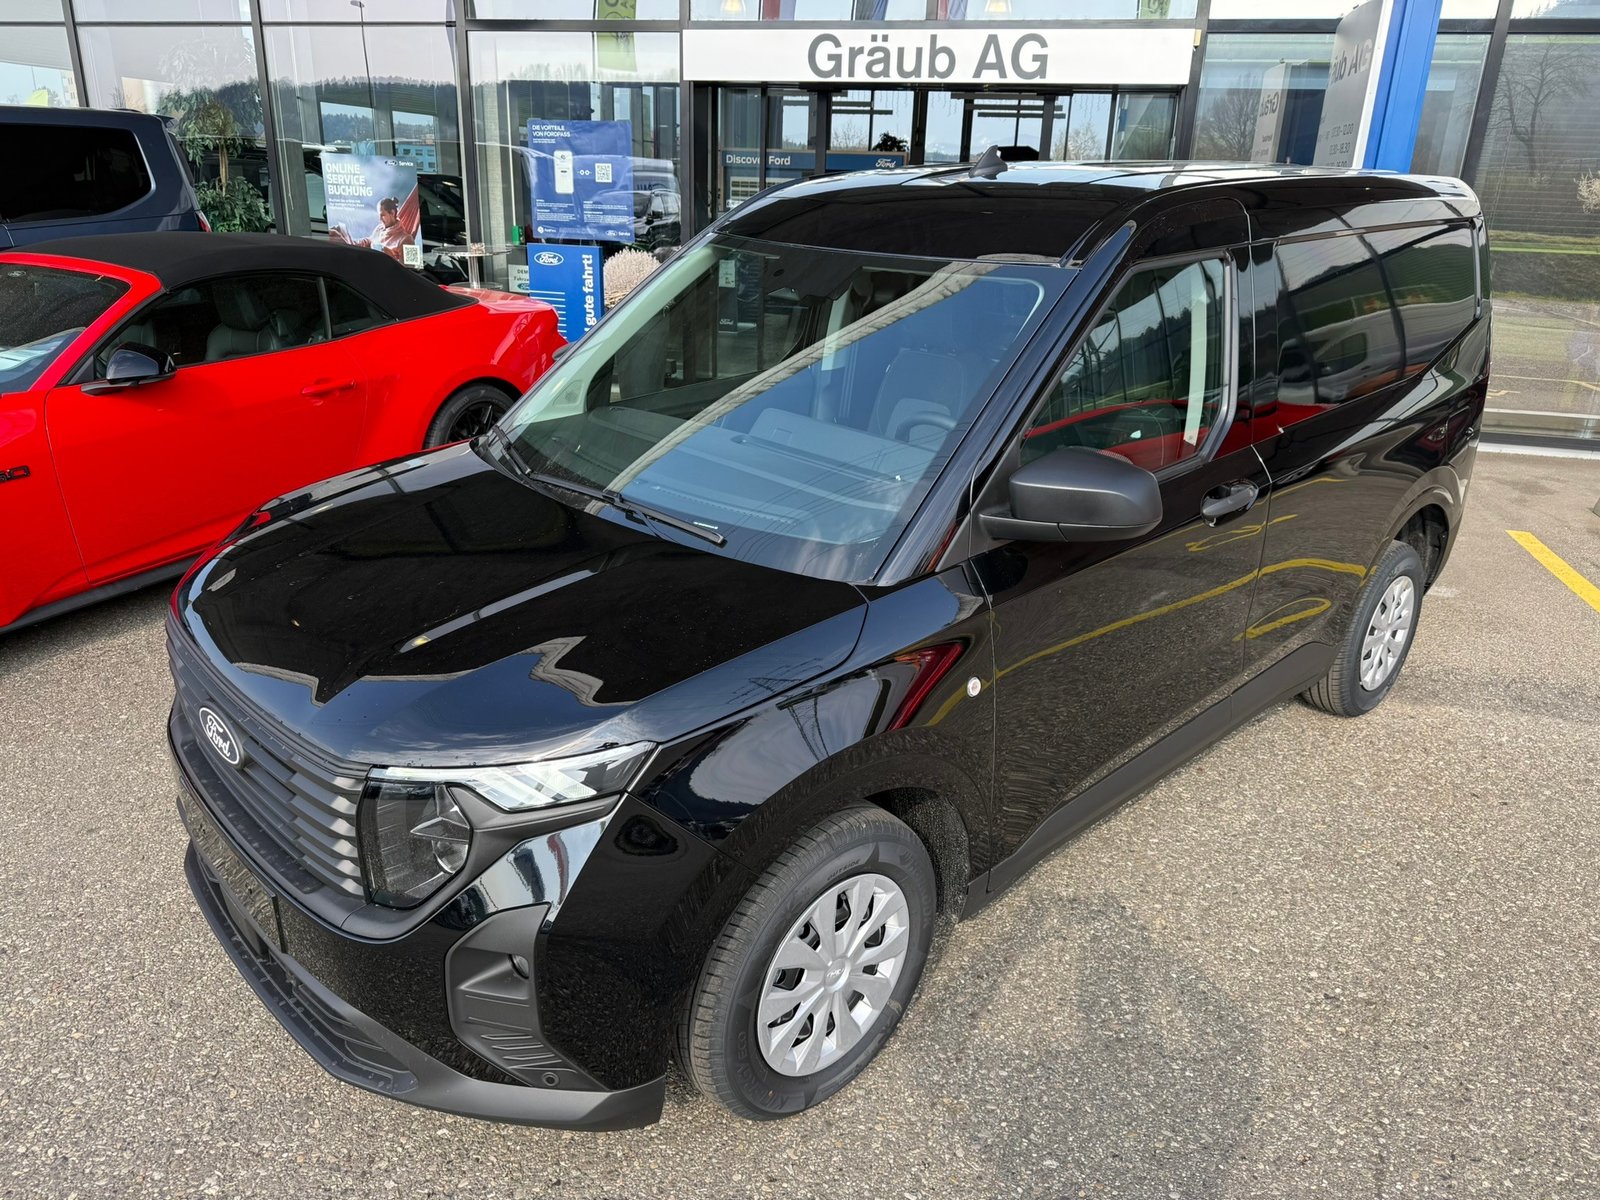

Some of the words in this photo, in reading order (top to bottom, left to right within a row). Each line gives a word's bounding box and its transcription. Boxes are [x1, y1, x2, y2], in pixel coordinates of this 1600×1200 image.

[807, 33, 956, 79] Gräub
[972, 32, 1049, 80] AG
[768, 155, 791, 166] Ford
[875, 158, 897, 168] Ford
[325, 163, 361, 174] ONLINE
[327, 174, 366, 185] SERVICE
[328, 184, 373, 197] BUCHUNG
[537, 252, 561, 265] Ford
[582, 254, 594, 293] fahrt!
[584, 295, 597, 326] gute
[203, 711, 234, 760] Ford
